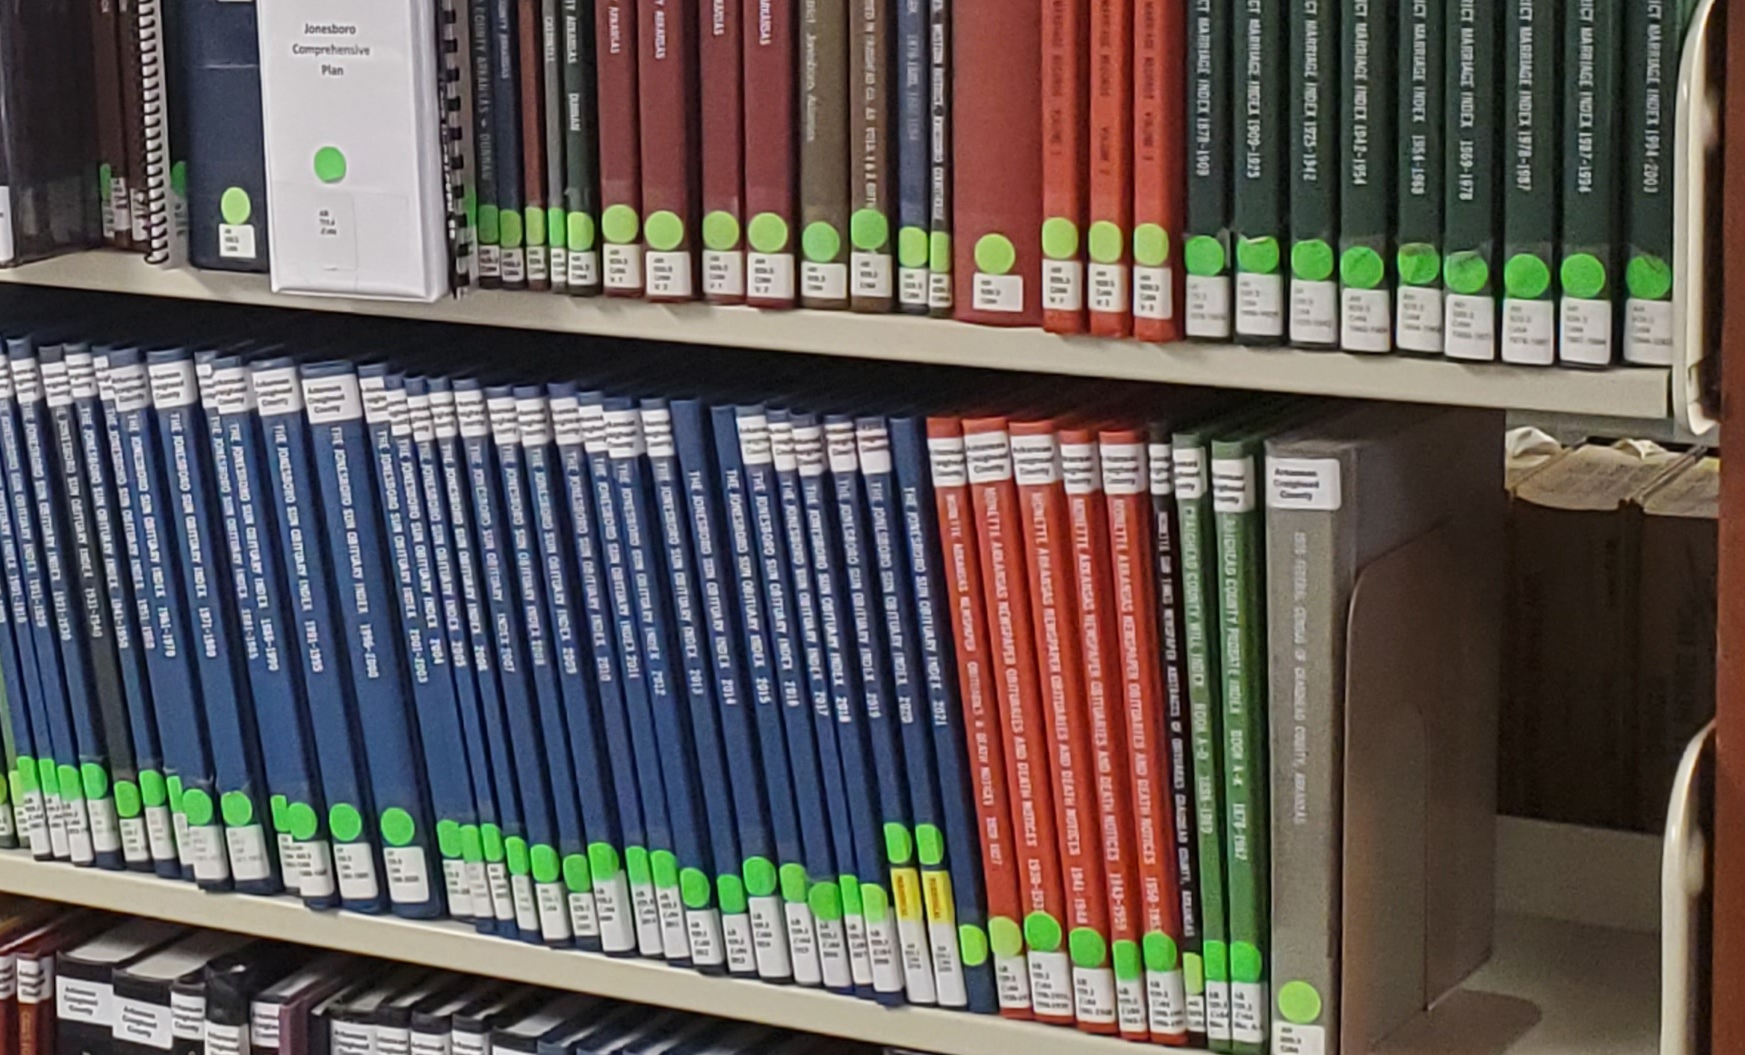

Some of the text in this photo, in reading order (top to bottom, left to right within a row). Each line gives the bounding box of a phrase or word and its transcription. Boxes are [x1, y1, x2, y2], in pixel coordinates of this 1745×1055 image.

[304, 23, 356, 34] Jonesboro
[292, 43, 370, 56] Comprehensive
[1353, 22, 1368, 80] MARRIAGE
[1459, 27, 1474, 87] MARRIAGE
[1518, 26, 1532, 85] MARRIAGE
[1646, 23, 1661, 84] MARRIAGE
[321, 65, 344, 76] Plan
[1353, 84, 1367, 120] INDEX
[1459, 91, 1474, 127] INDEX
[1517, 90, 1532, 126] INDEX
[1645, 88, 1660, 125] INDEX
[687, 470, 703, 491] THE
[902, 486, 918, 508] THE
[691, 493, 712, 555] JONESBORO
[905, 510, 926, 573] JONESBORO
[701, 557, 716, 579] SUN
[914, 574, 929, 599] SUN
[705, 580, 725, 633] OBITUARY
[918, 599, 937, 653] OBITUARY
[714, 635, 730, 669] INDEX
[925, 655, 942, 690] INDEX
